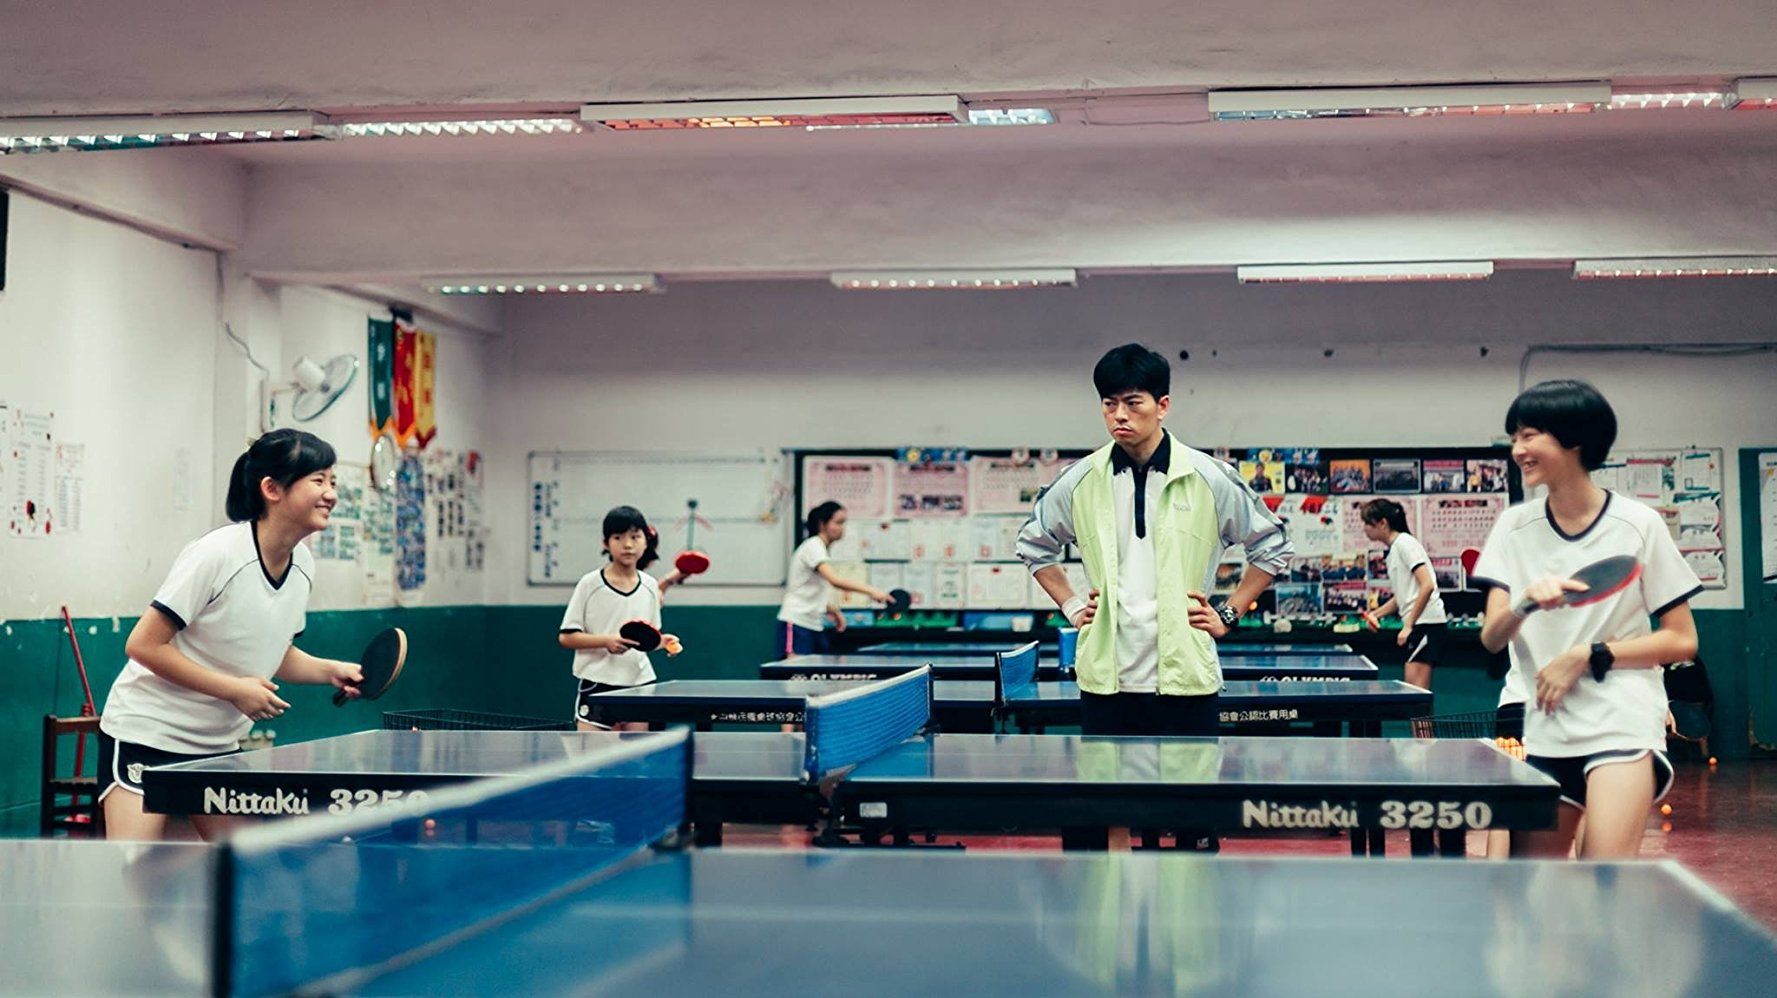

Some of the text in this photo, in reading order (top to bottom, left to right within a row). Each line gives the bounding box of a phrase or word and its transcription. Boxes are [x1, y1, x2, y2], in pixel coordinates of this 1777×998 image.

[203, 786, 309, 815] Nittaku
[1242, 799, 1493, 830] Nittaku 3250
